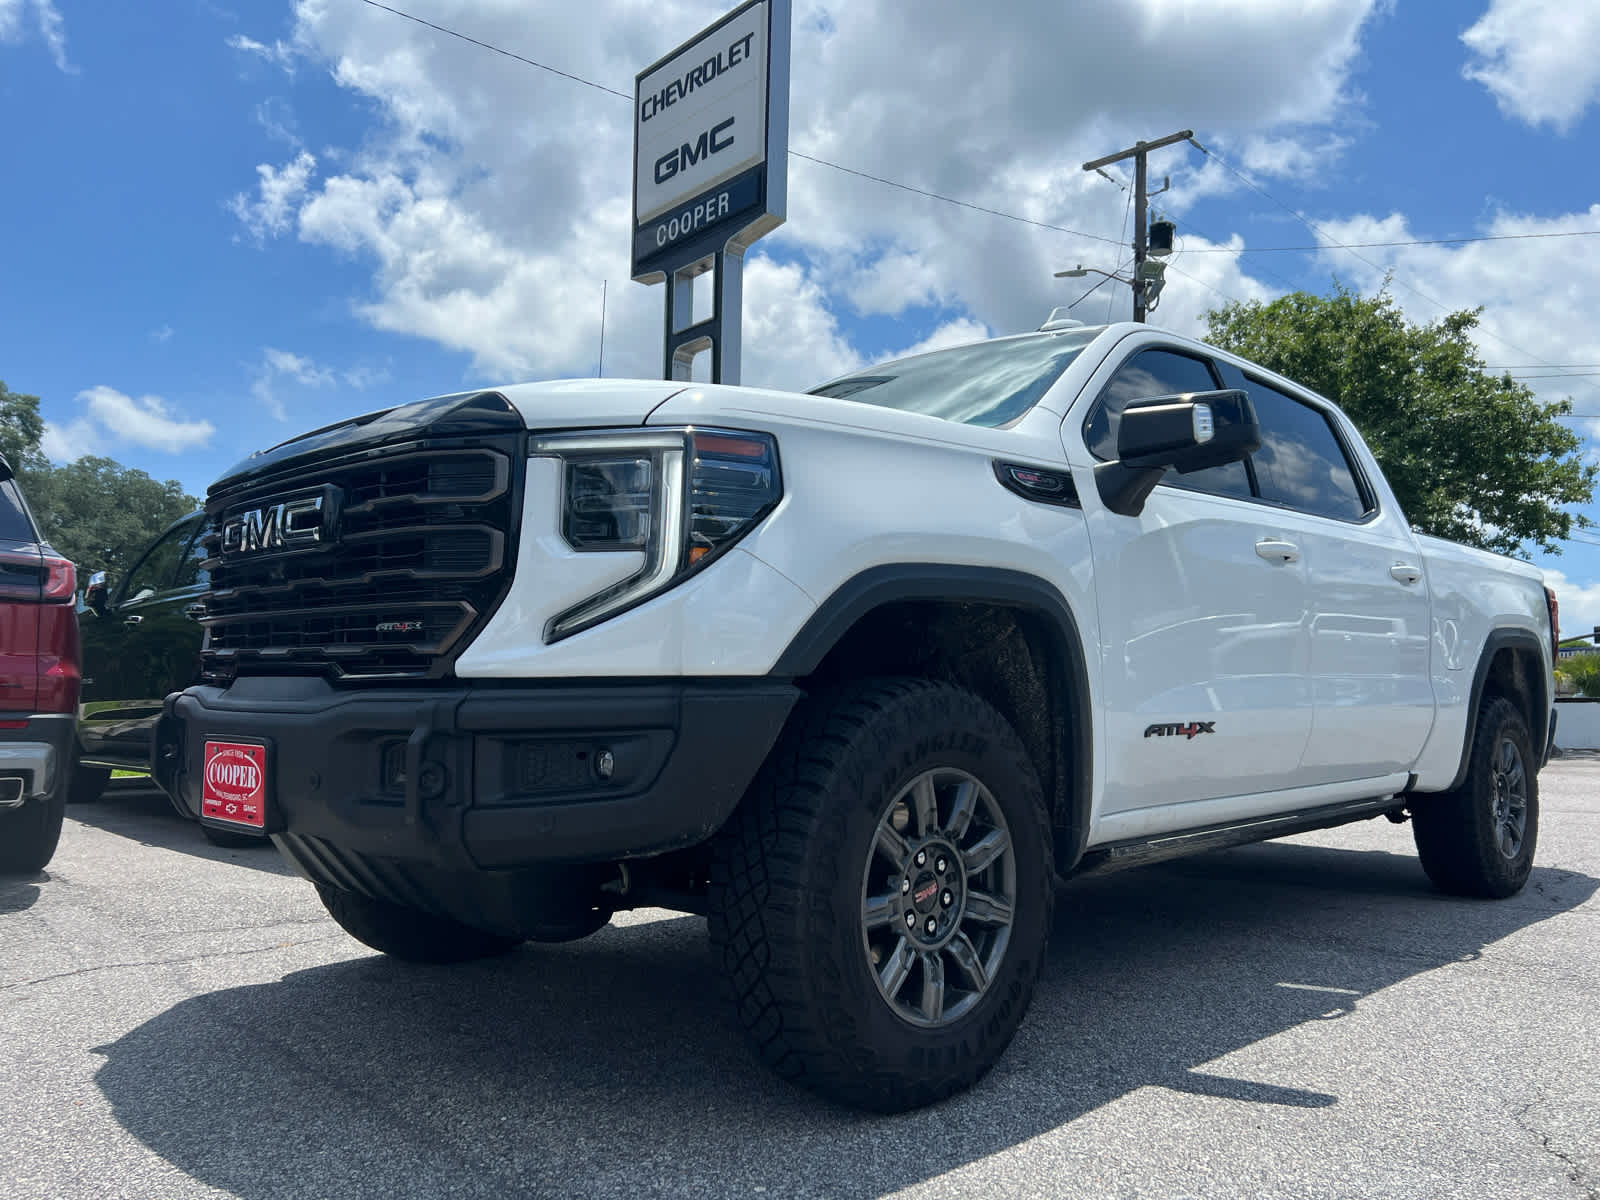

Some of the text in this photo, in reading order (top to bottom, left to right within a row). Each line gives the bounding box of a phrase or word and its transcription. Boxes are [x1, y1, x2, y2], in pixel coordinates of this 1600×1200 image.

[641, 32, 755, 122] CHEVROLET
[654, 116, 735, 185] GMC
[656, 192, 729, 247] COOPER
[221, 496, 323, 554] GMC
[375, 621, 423, 632] AT4X
[1143, 721, 1216, 740] AT4X
[210, 762, 256, 788] COOPER
